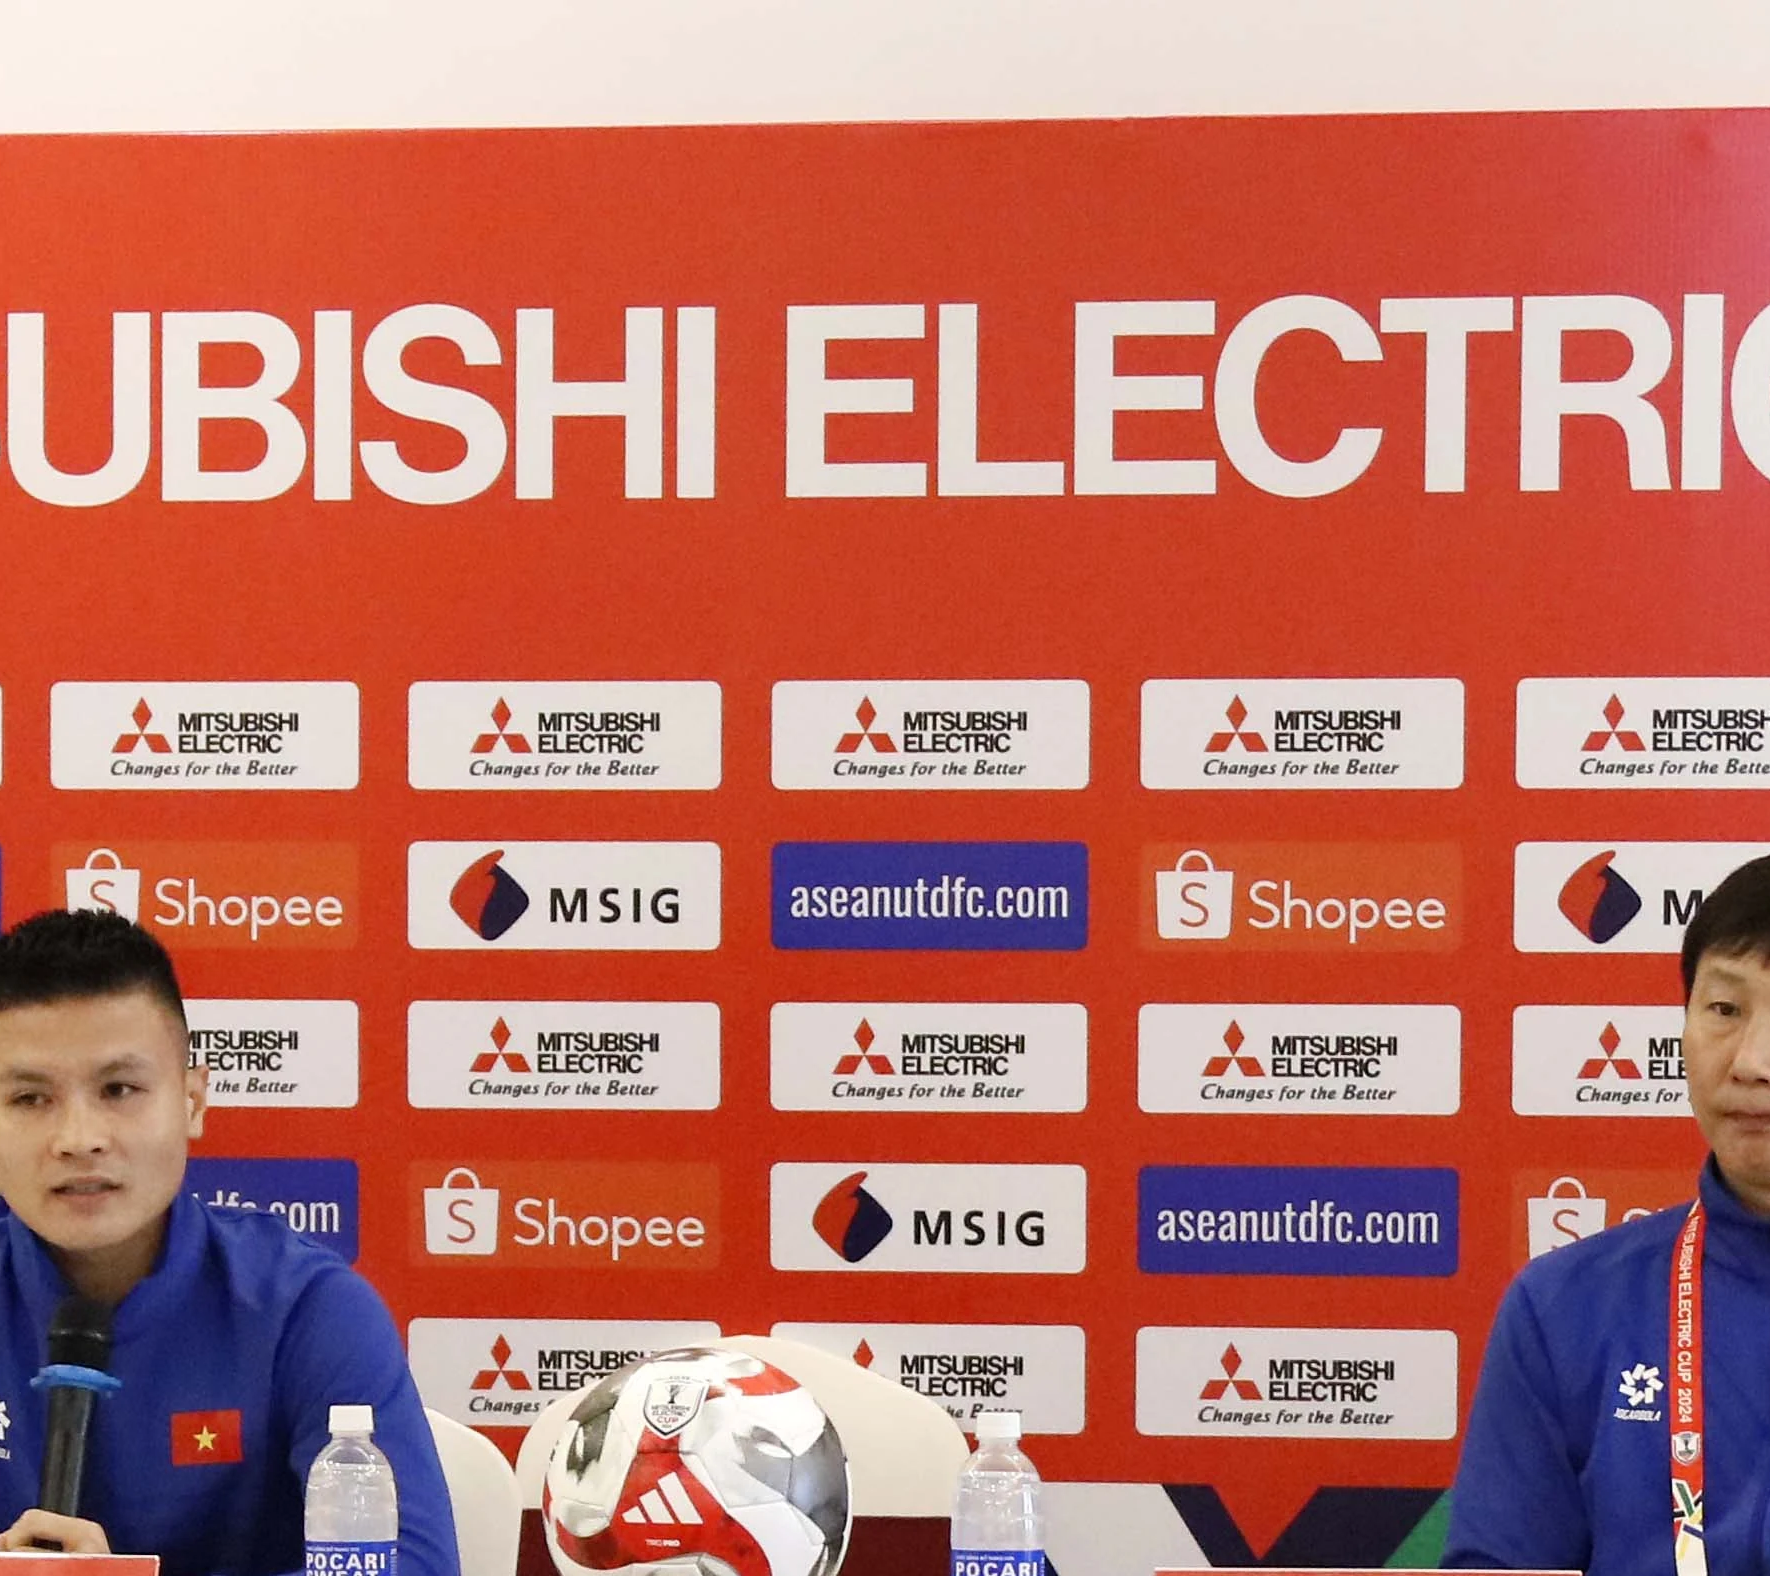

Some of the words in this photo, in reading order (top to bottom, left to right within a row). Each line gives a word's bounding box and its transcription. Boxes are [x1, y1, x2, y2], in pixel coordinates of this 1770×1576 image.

[539, 712, 660, 732] MITSUBISHI
[539, 734, 643, 753] ELECTRIC
[1653, 731, 1763, 751] ELECTRIC
[469, 760, 540, 778] Changes
[545, 762, 571, 777] for
[576, 762, 601, 776] the
[607, 760, 659, 776] Better
[1580, 758, 1654, 777] Changes
[1660, 760, 1687, 776] for
[1692, 760, 1718, 774] the
[551, 888, 679, 923] MSIG
[791, 876, 1067, 917] aseanutdfc.com
[155, 879, 342, 940] Shopee
[1249, 880, 1445, 943] Shopee
[902, 1034, 1025, 1054] MITSUBISHI
[902, 1056, 1008, 1075] ELECTRIC
[832, 1081, 904, 1100] Changes
[909, 1084, 935, 1099] for
[940, 1084, 965, 1097] the
[972, 1082, 1024, 1098] Better
[514, 1198, 704, 1260] Shopee
[914, 1211, 1044, 1246] MSIG
[1158, 1200, 1438, 1243] aseanutdfc.com
[1677, 1282, 1692, 1348] ELECTRIC
[900, 1354, 1024, 1376] MITSUBISHI
[1270, 1360, 1394, 1380] MITSUBISHI
[1677, 1351, 1692, 1383] CUP
[1269, 1381, 1377, 1402] ELECTRIC
[1198, 1406, 1271, 1426] Changes
[1276, 1409, 1302, 1425] for
[1308, 1410, 1334, 1424] the
[1340, 1408, 1394, 1425] Better
[1677, 1388, 1692, 1424] 2024
[307, 1553, 385, 1569] POCARI
